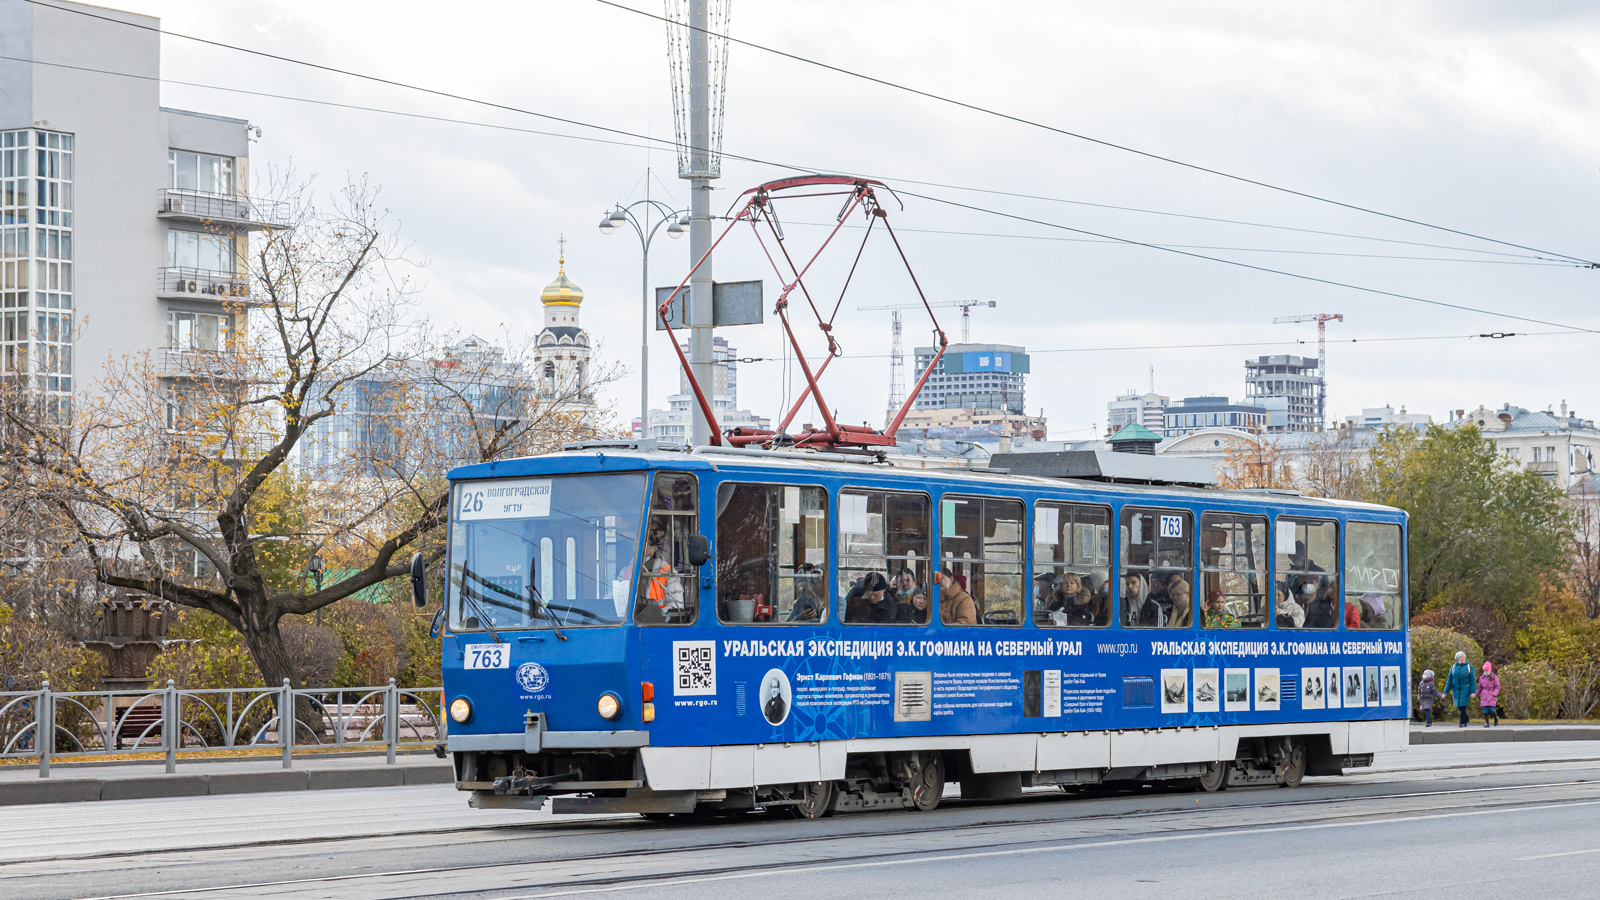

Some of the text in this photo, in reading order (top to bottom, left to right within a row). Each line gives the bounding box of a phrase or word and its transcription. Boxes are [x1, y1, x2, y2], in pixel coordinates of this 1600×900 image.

[462, 491, 484, 512] 26
[503, 504, 522, 512] УГТУ
[1162, 517, 1180, 536] 763
[724, 638, 1082, 659] УРАЛЬСКАЯ ЭКСПЕДИЦИЯ Э.К.ГОФМАНА НА СЕВЕРНЫЙ УРАЛ
[1097, 643, 1138, 657] www.rgo.ru
[1151, 639, 1402, 658] УРАЛЬСКАЯ ЭКСПЕДИЦИЯ Э.К.ГОФМАНА НА СЕВЕРНЫЙ УРАЛ
[472, 650, 502, 668] 763
[797, 673, 814, 682] Эрнст
[843, 673, 863, 682] Гофман
